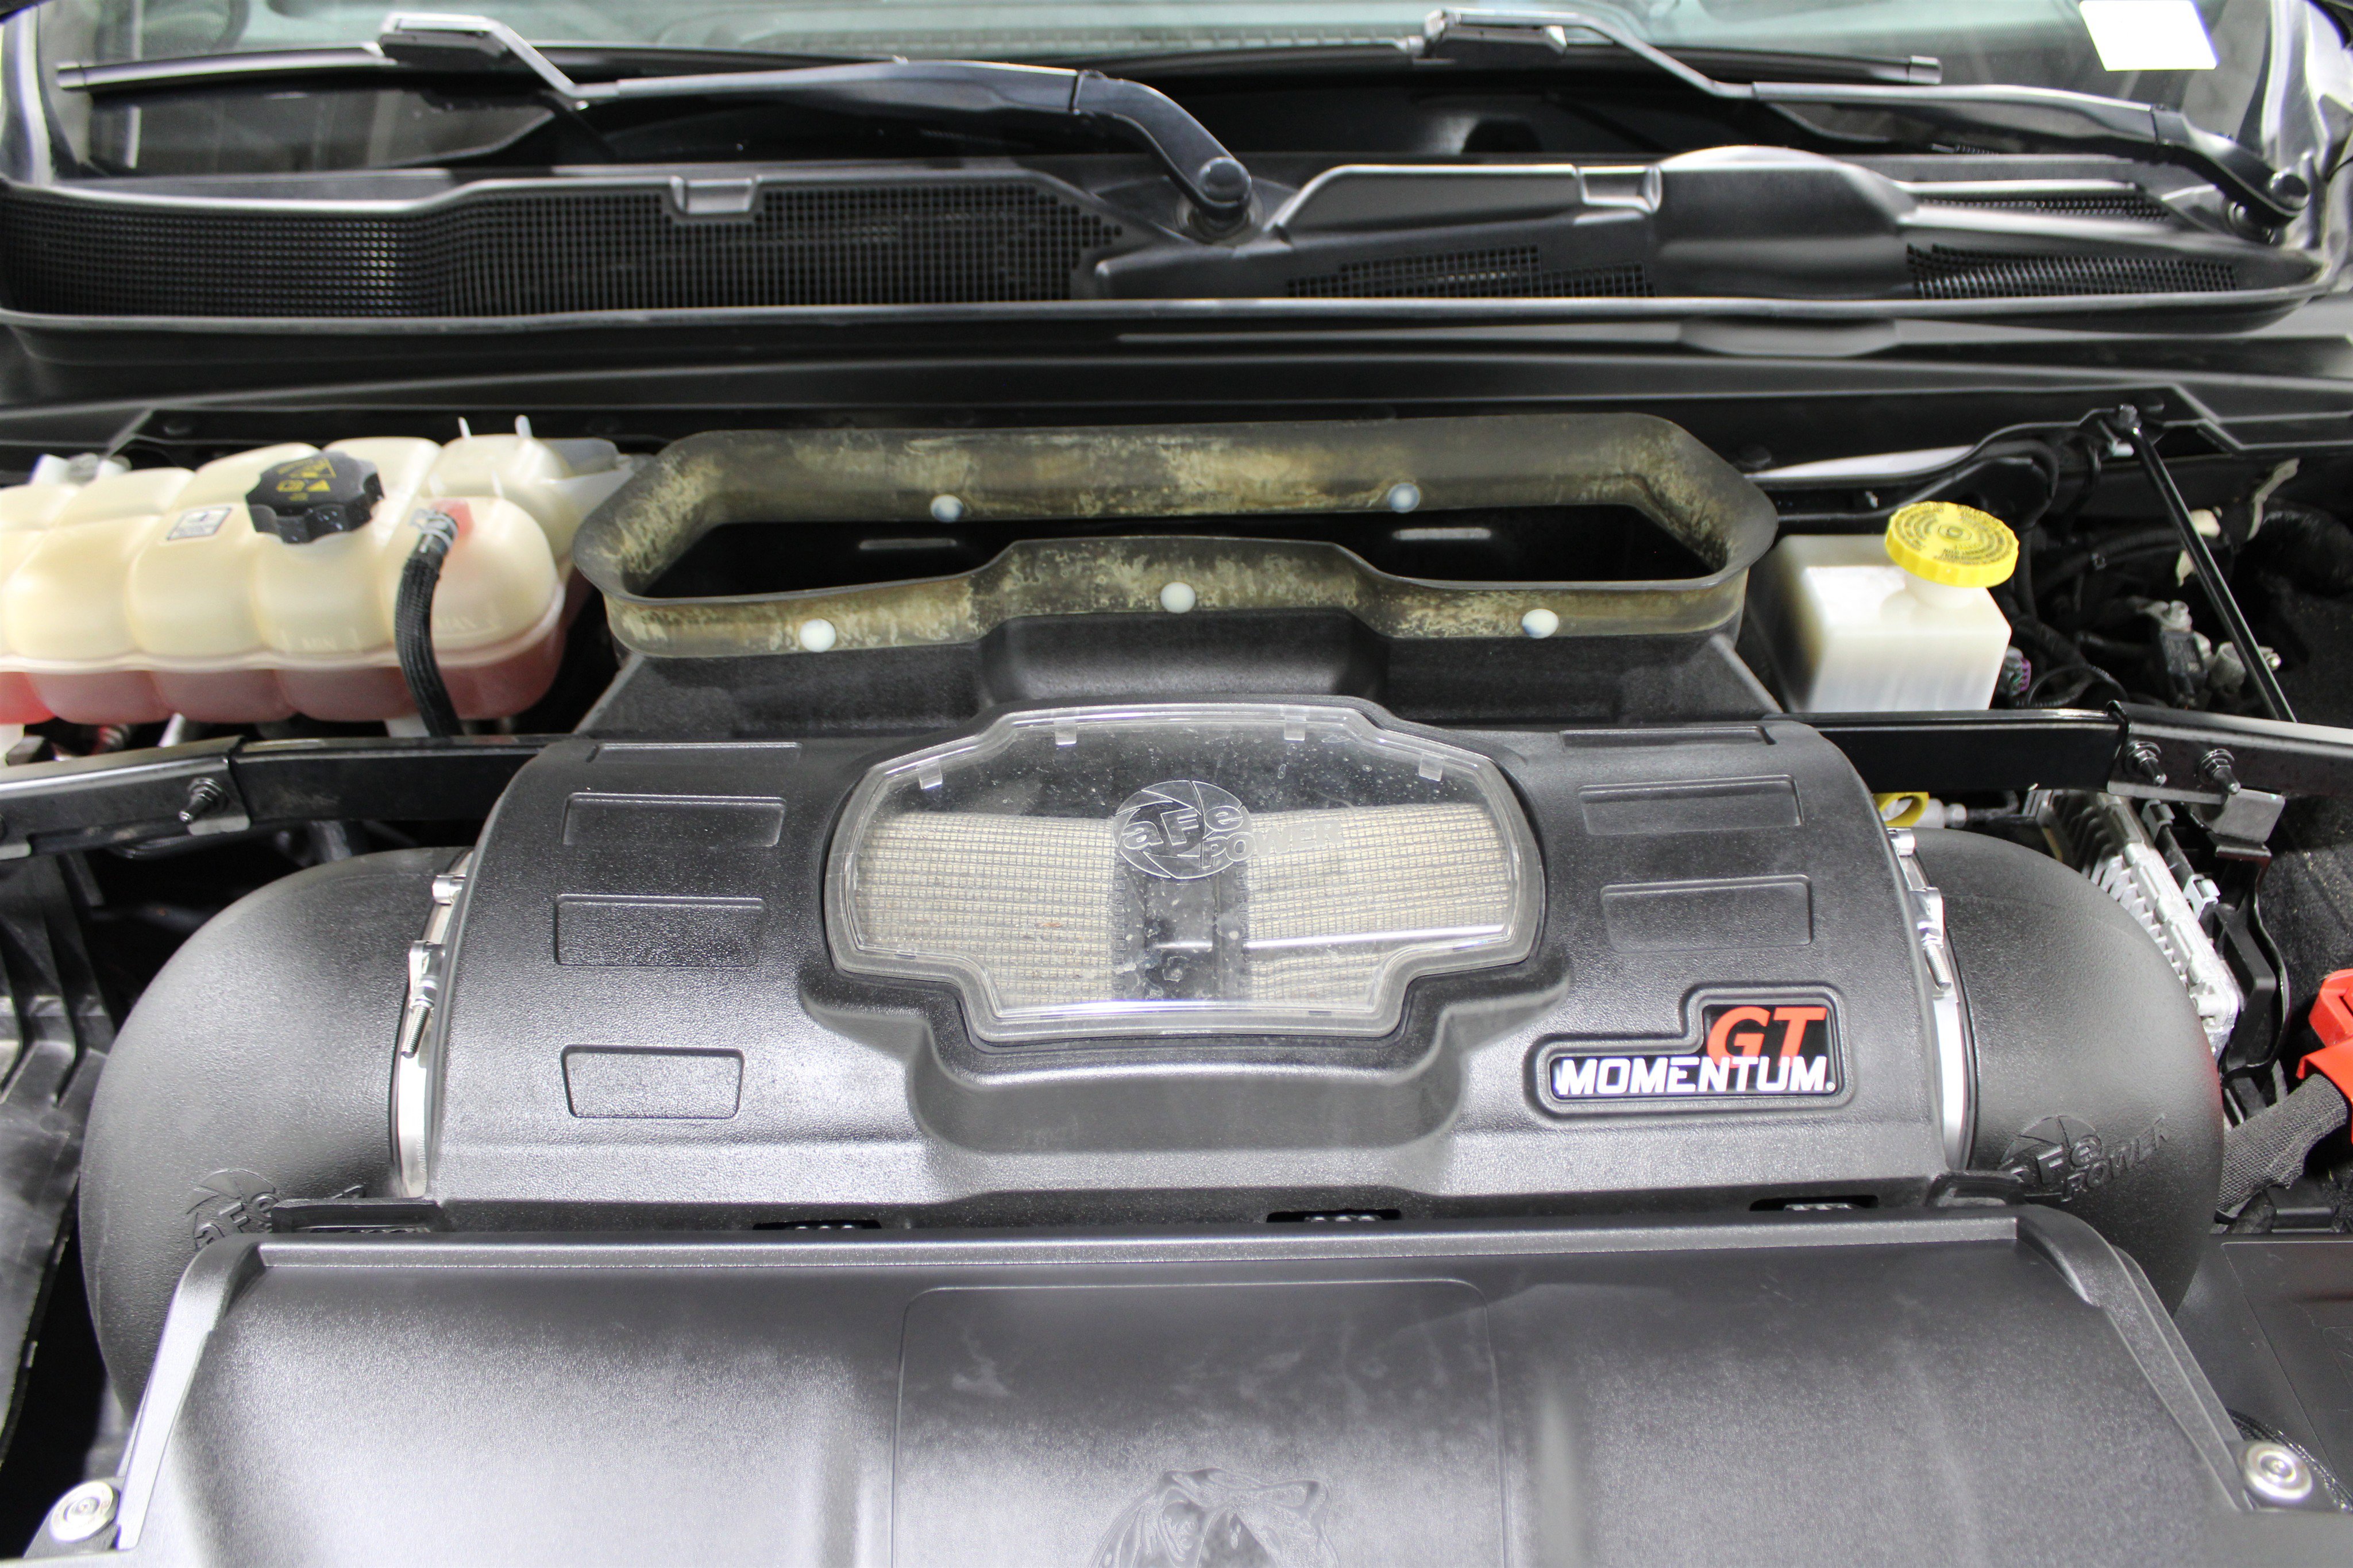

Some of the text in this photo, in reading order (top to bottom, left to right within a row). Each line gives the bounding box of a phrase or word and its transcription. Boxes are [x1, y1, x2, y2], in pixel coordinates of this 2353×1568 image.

[1123, 806, 1244, 850] aFe
[1201, 818, 1345, 869] POWER
[1706, 1006, 1828, 1068] GT
